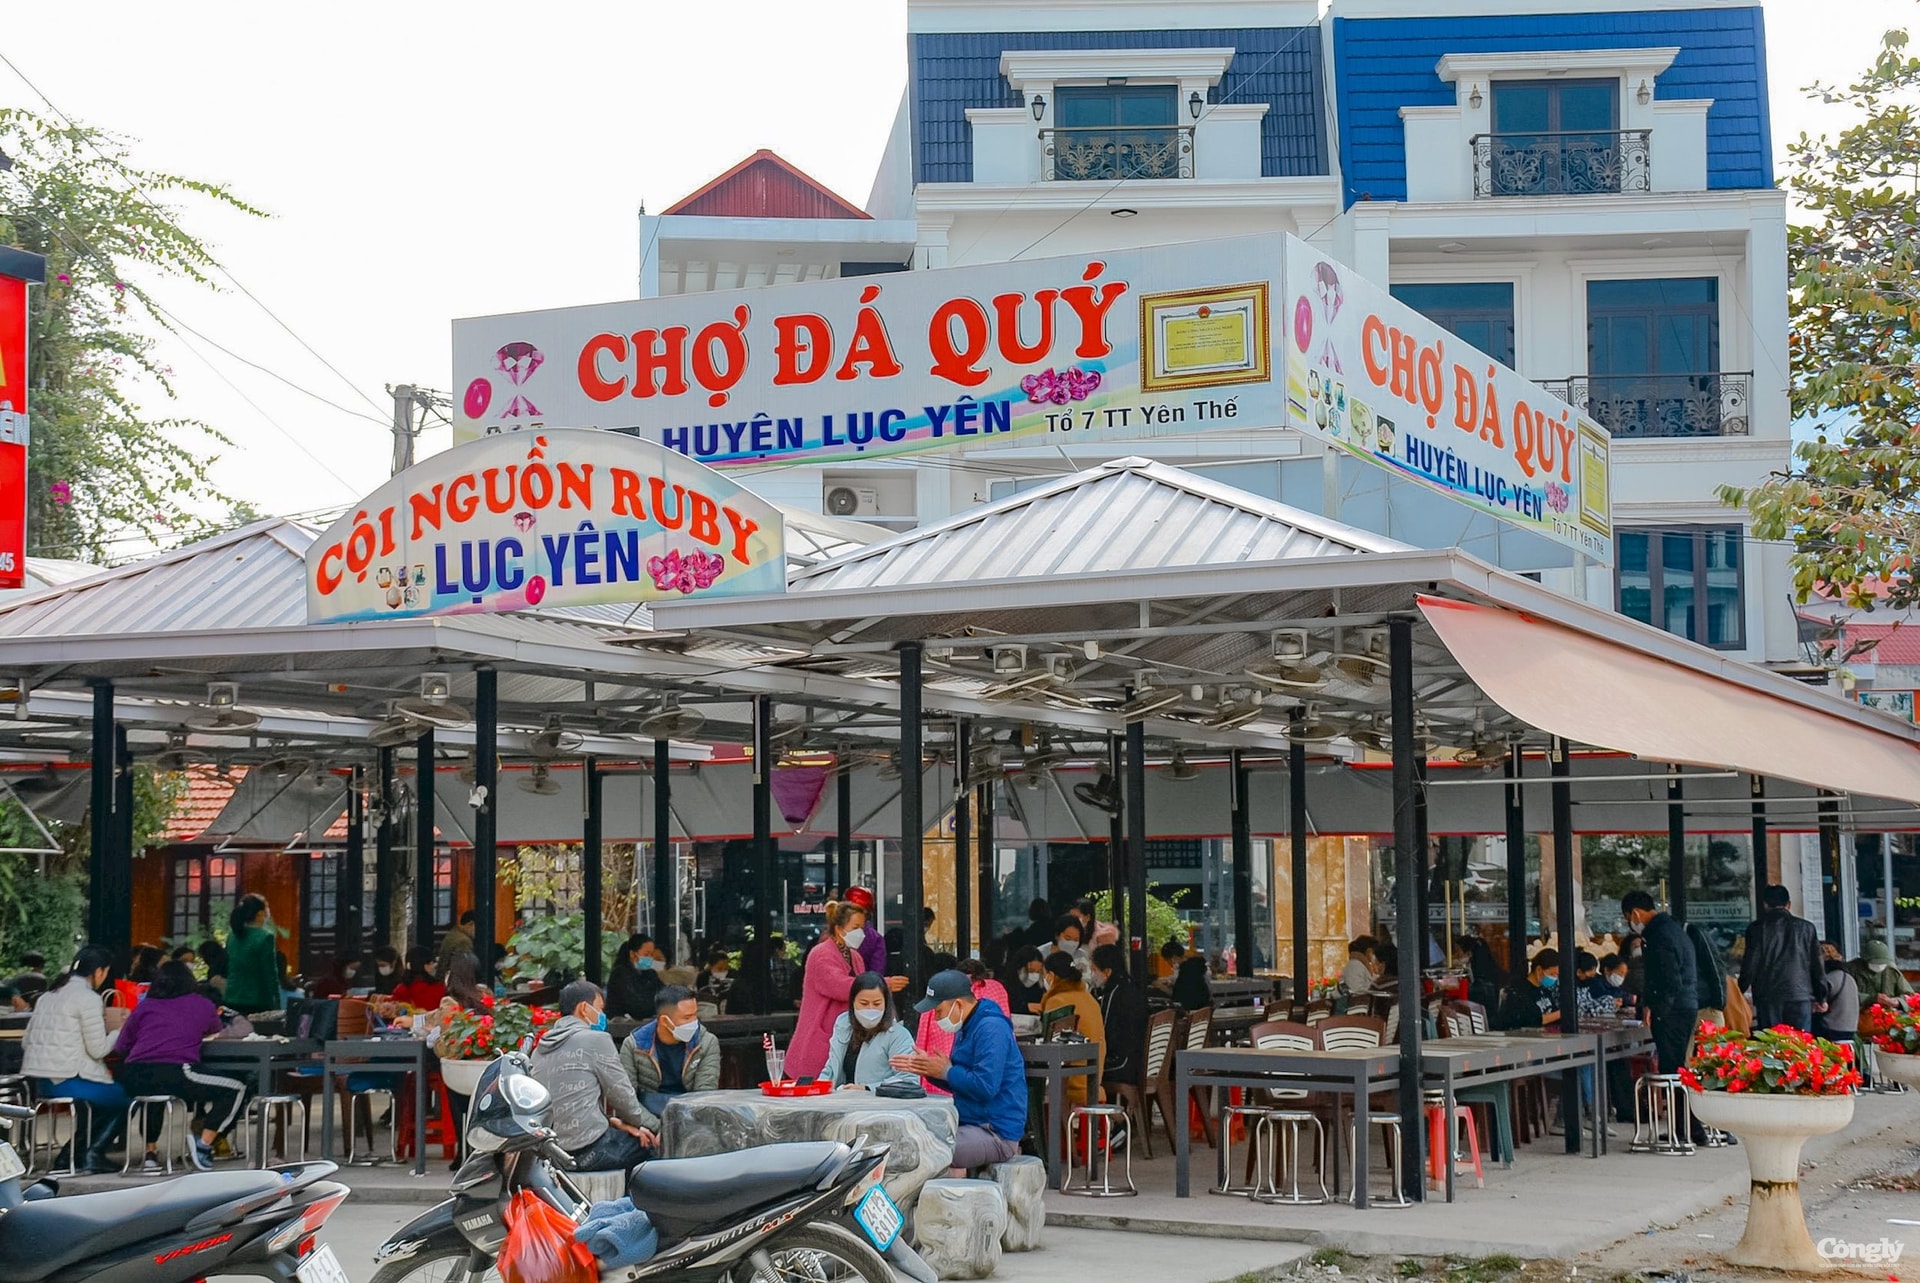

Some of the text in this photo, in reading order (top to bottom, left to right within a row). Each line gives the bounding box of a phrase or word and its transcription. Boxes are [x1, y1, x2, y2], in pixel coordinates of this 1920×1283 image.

[577, 261, 1129, 407] CHỢ ĐÁ QUÝ
[1045, 395, 1239, 432] Tổ 7 TT Yên Thế
[1361, 313, 1444, 429] CHỢ
[1453, 364, 1504, 449] ĐÁ
[1513, 400, 1575, 483] QUÝ
[662, 394, 1011, 458] HUYỆN LỤC YÊN
[1405, 433, 1543, 522] HUYỆN LỤC YÊN
[316, 435, 759, 596] CỘI NGUỒN RUBY
[1563, 520, 1568, 537] 7
[1570, 525, 1578, 541] TT
[434, 520, 641, 605] LỤC YÊN
[462, 1213, 494, 1232] YAMAHA
[703, 1216, 766, 1252] JUPITER
[875, 1208, 898, 1243] 6910
[154, 1232, 234, 1265] VISION
